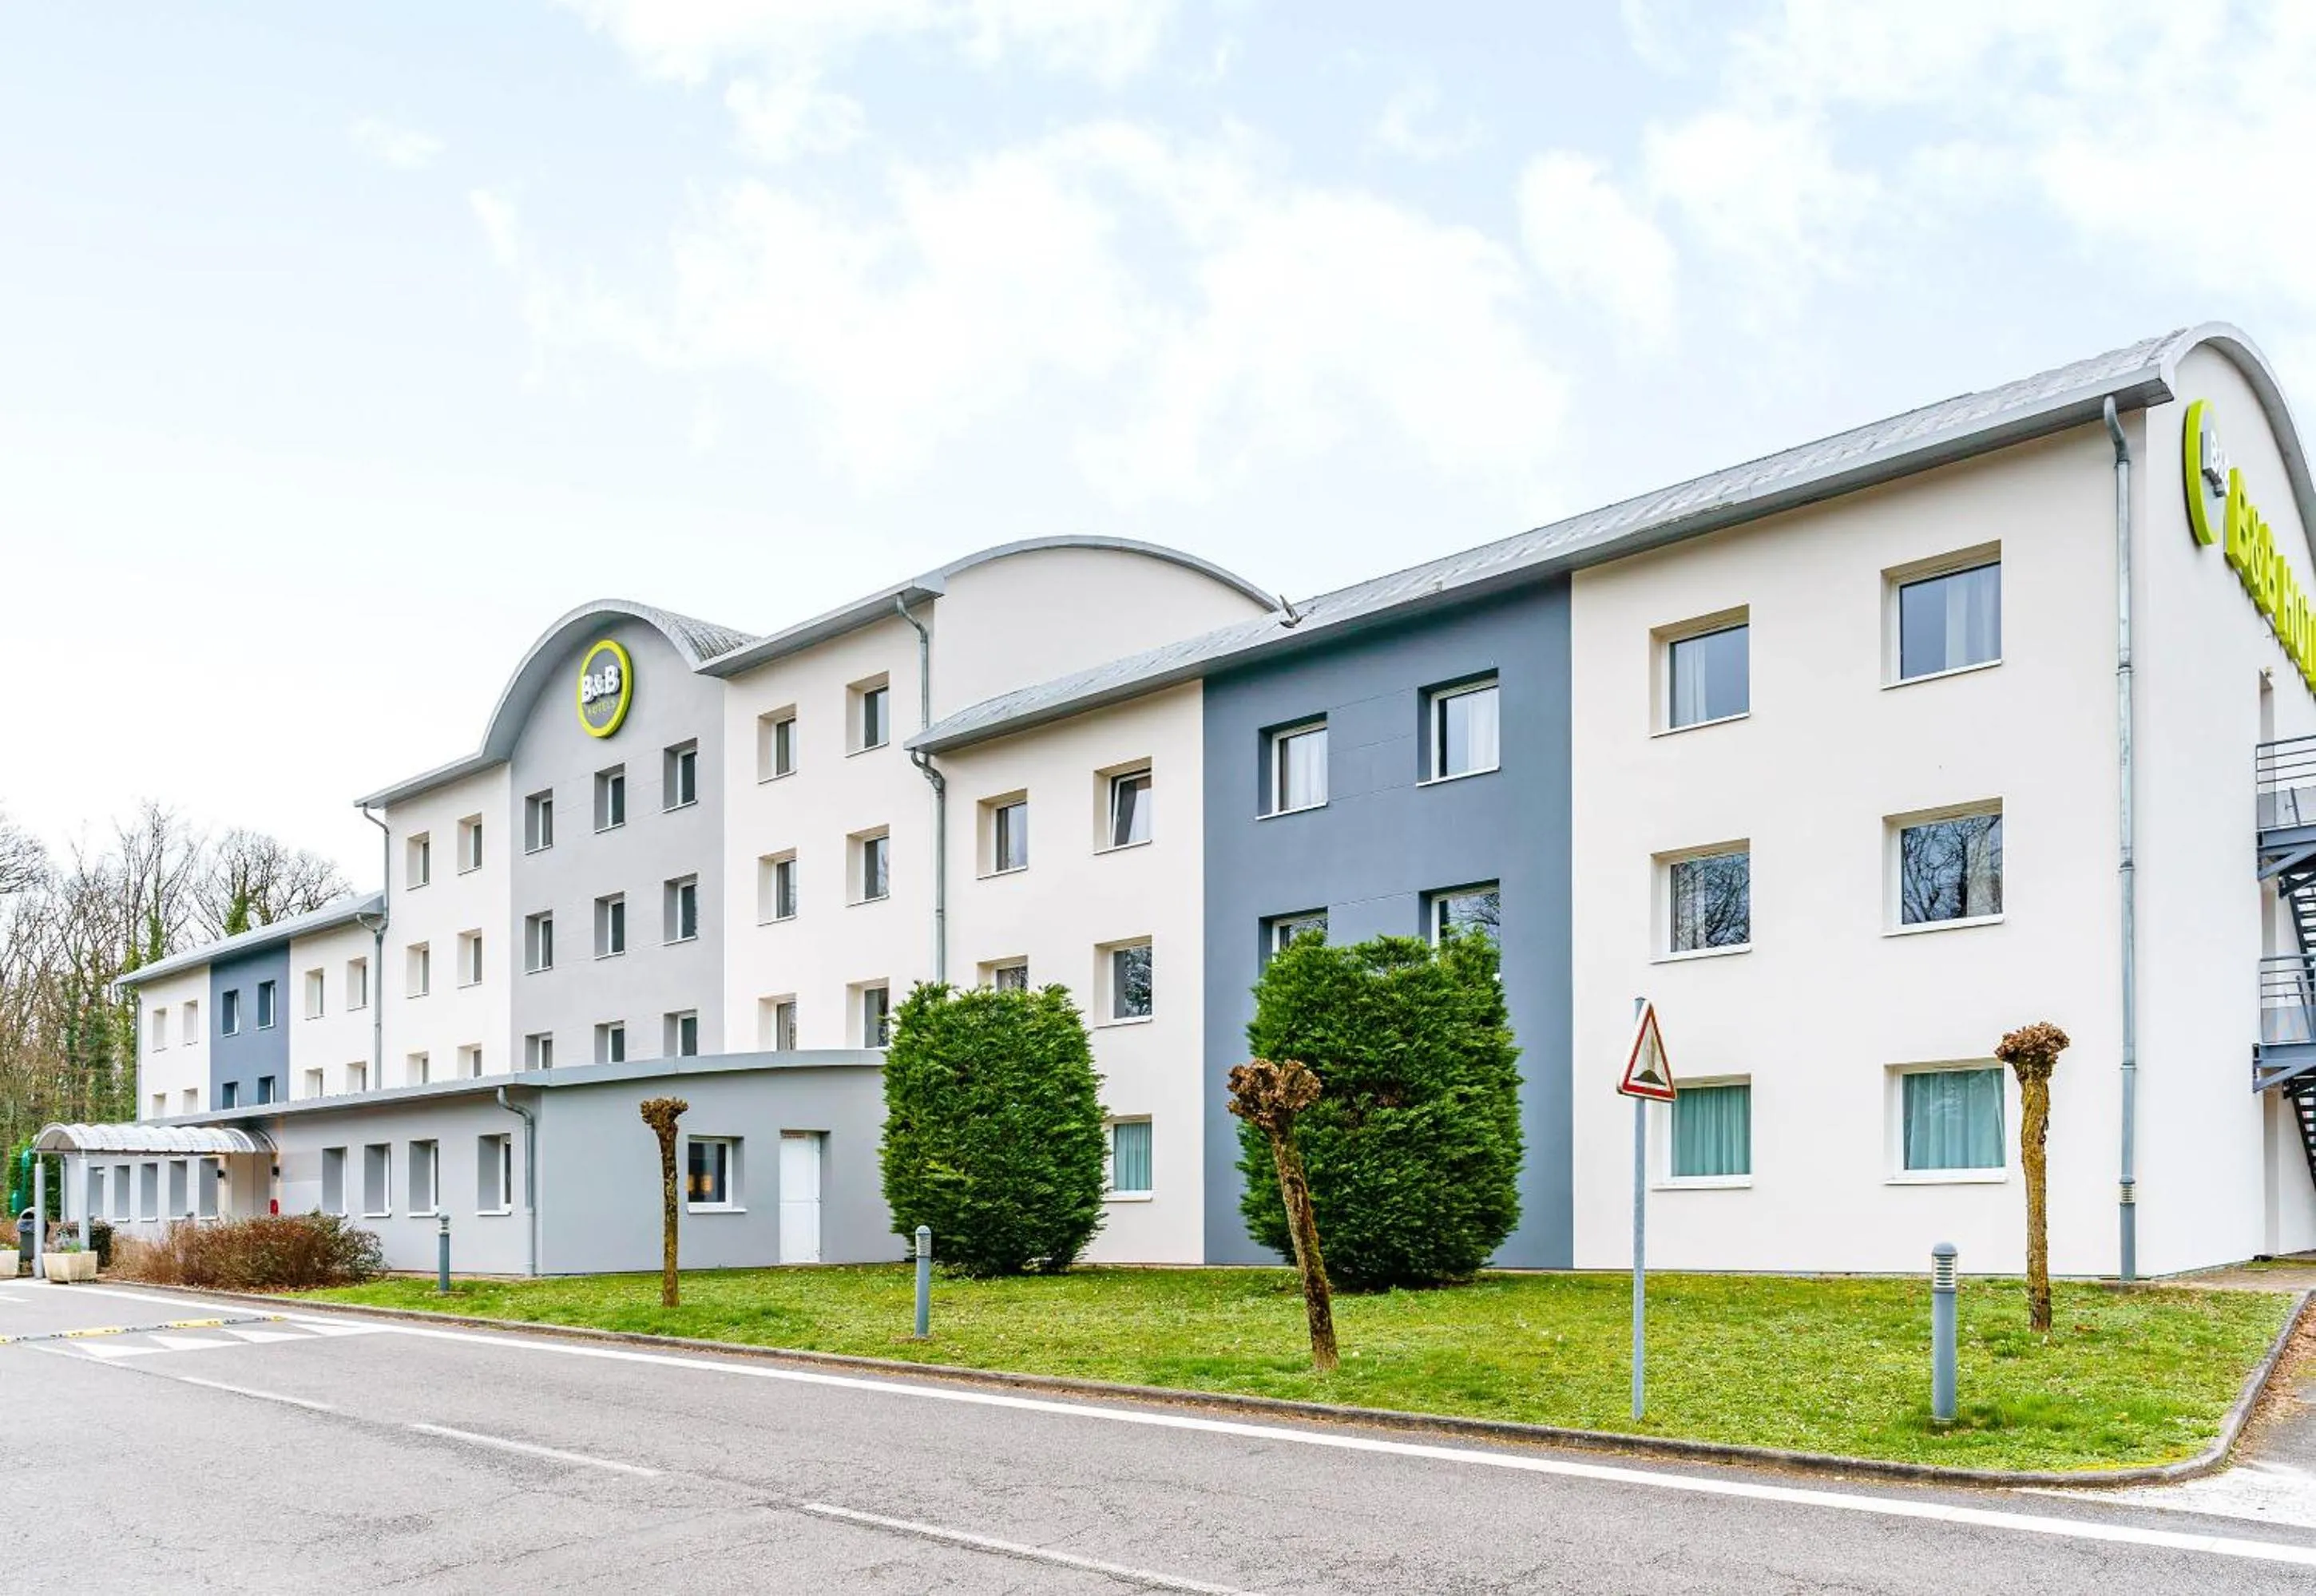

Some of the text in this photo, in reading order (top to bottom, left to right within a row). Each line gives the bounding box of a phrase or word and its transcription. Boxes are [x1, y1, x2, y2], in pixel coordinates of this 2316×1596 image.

[2227, 467, 2316, 693] B&B HOT
[581, 664, 620, 703] B&B
